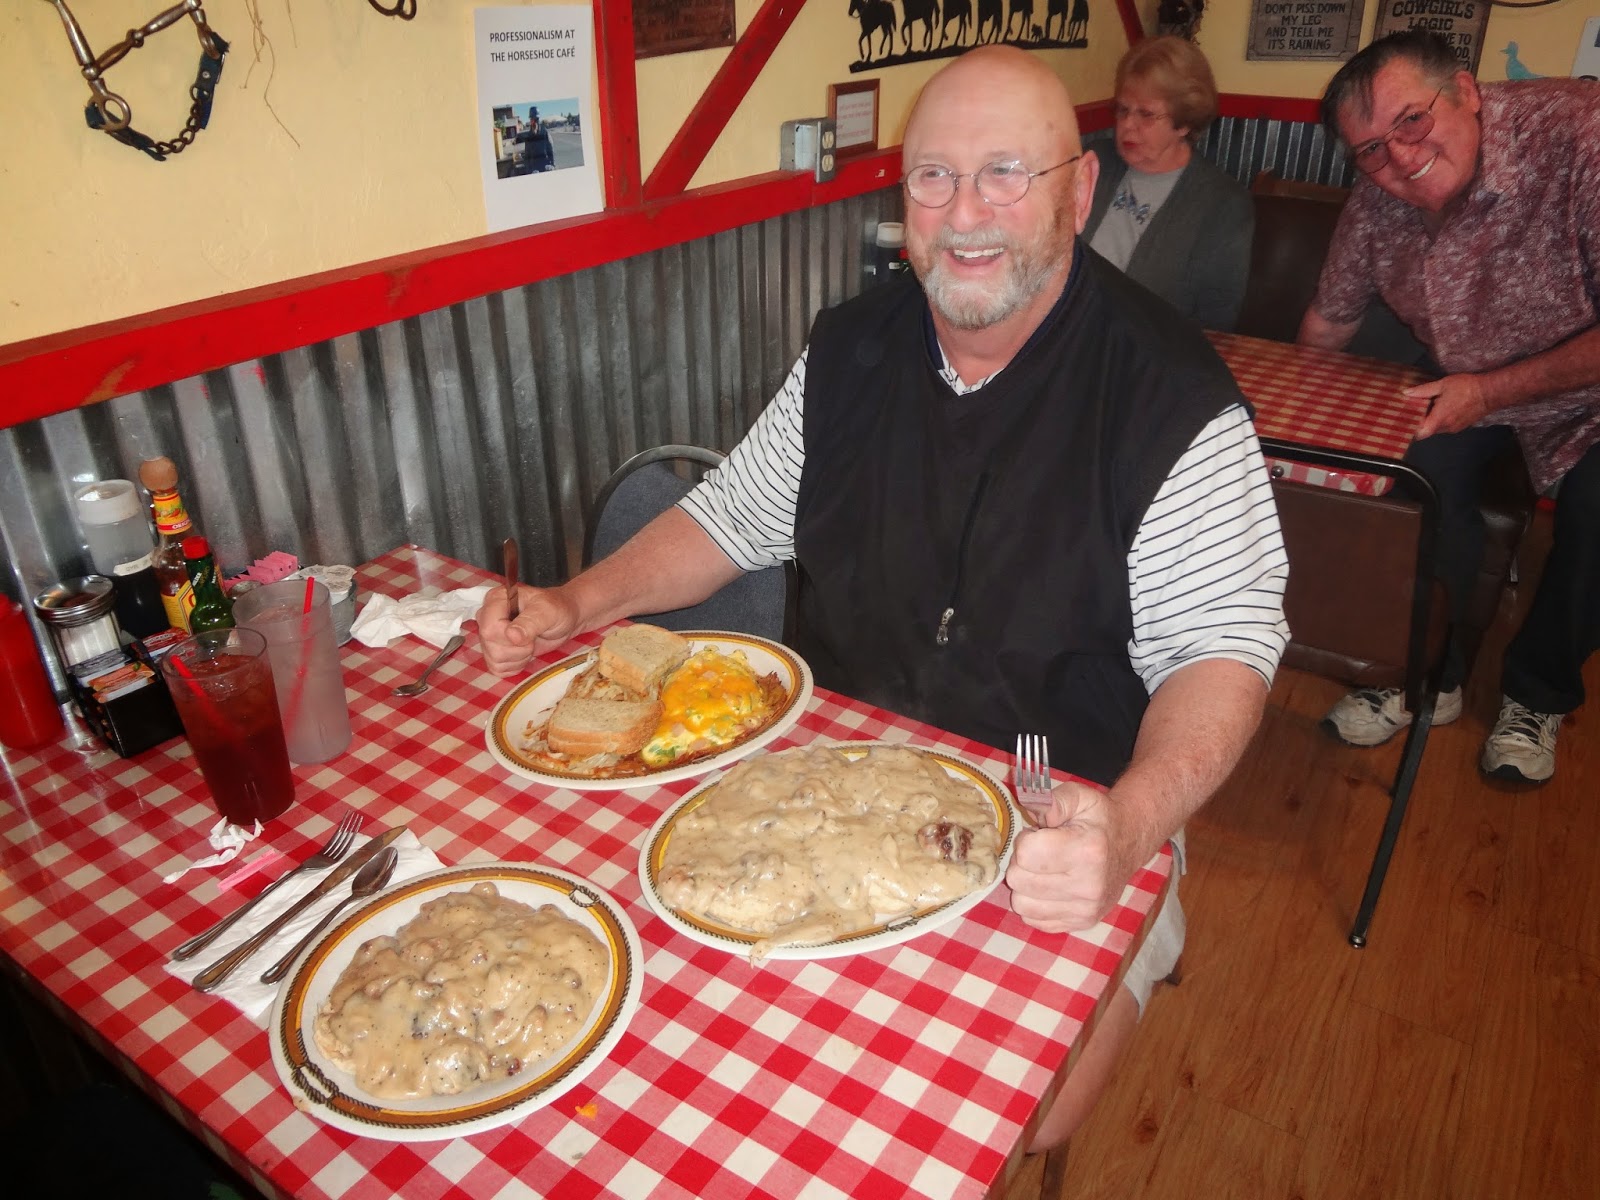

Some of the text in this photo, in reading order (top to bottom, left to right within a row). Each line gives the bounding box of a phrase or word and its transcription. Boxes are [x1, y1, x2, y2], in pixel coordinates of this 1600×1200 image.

[1265, 3, 1346, 14] DON'T PISS DOWN
[1392, 0, 1475, 19] COWGIRL'S
[1281, 15, 1322, 26] MY LEG
[1408, 17, 1453, 31] LOGIC
[490, 29, 575, 43] PROFESSIONALISM AT
[1265, 26, 1334, 38] AND TELL ME
[1268, 39, 1331, 50] IT'S RAINING
[1459, 33, 1472, 46] TO
[491, 45, 575, 63] THE HORSESHOE CAFÉ
